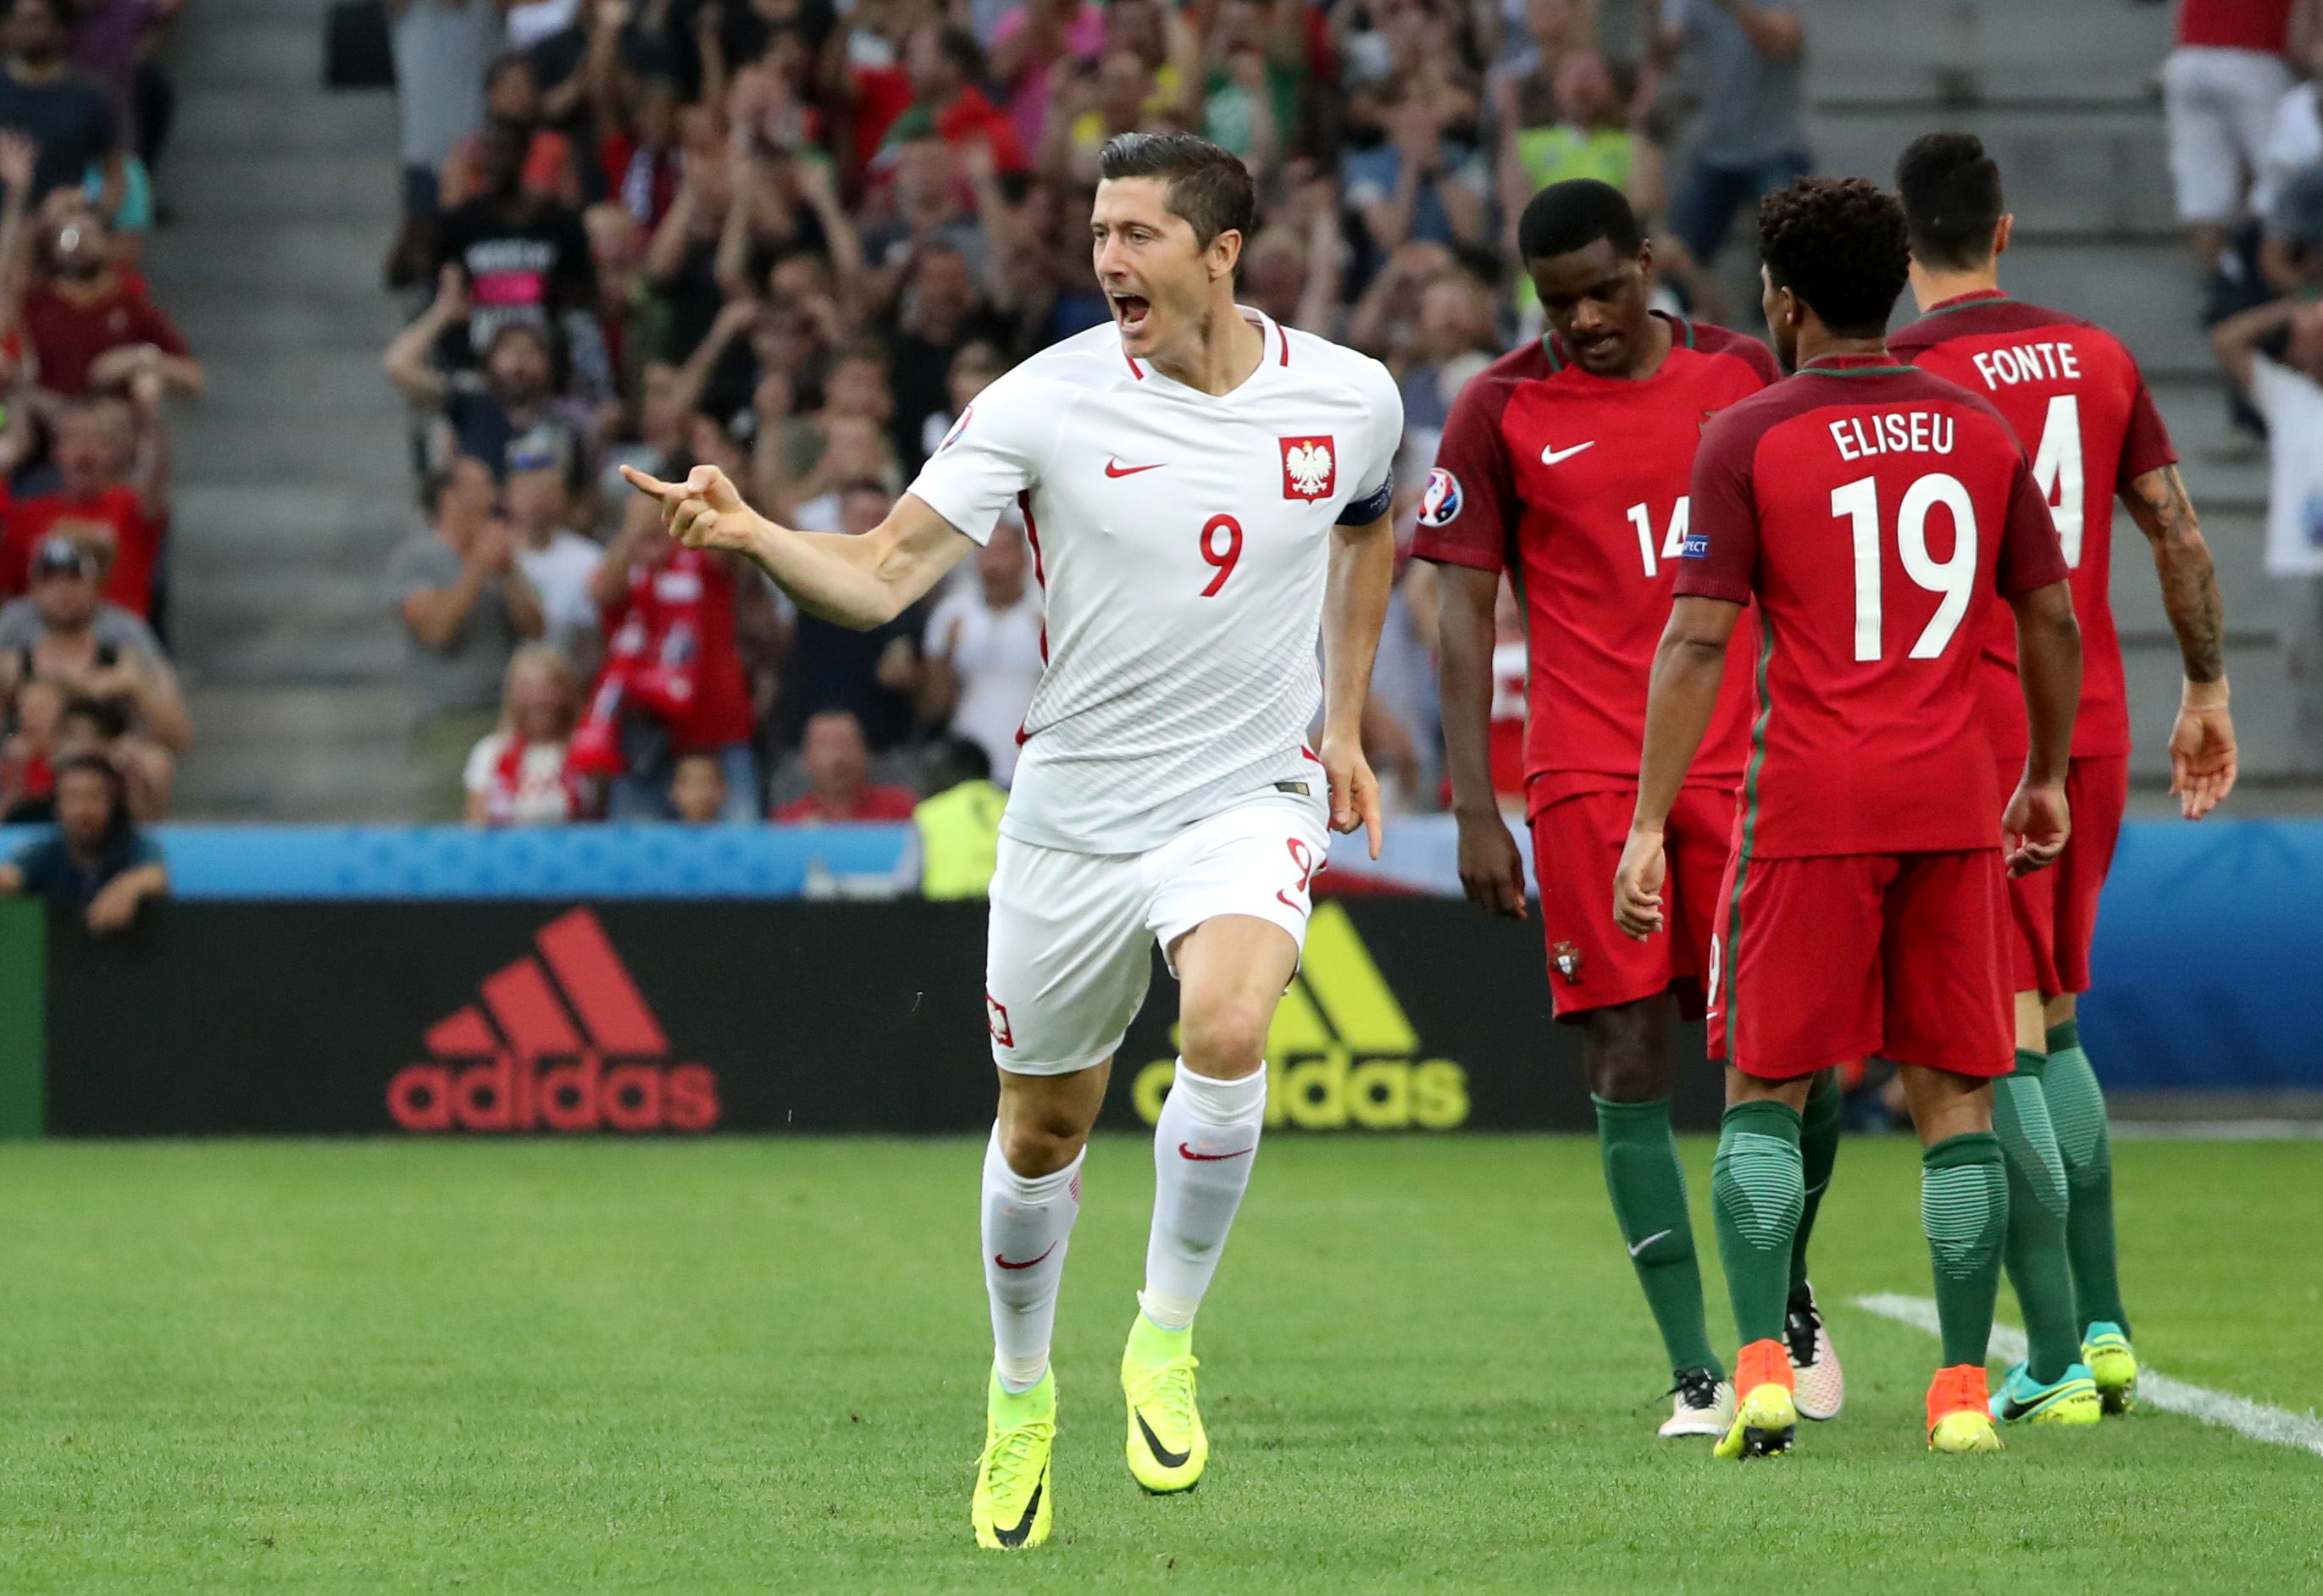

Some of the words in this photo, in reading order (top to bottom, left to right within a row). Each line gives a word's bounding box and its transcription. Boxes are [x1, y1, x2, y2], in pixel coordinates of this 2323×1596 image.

[1972, 342, 2081, 391] FONTE
[1829, 412, 1954, 461] ELISEU
[2032, 394, 2084, 568] 4
[1200, 513, 1244, 597] 9
[1627, 495, 1691, 578] 14
[1831, 473, 1978, 662] 19
[1286, 836, 1311, 893] 9
[386, 1051, 721, 1131] adidas
[1132, 1048, 1470, 1129] idas
